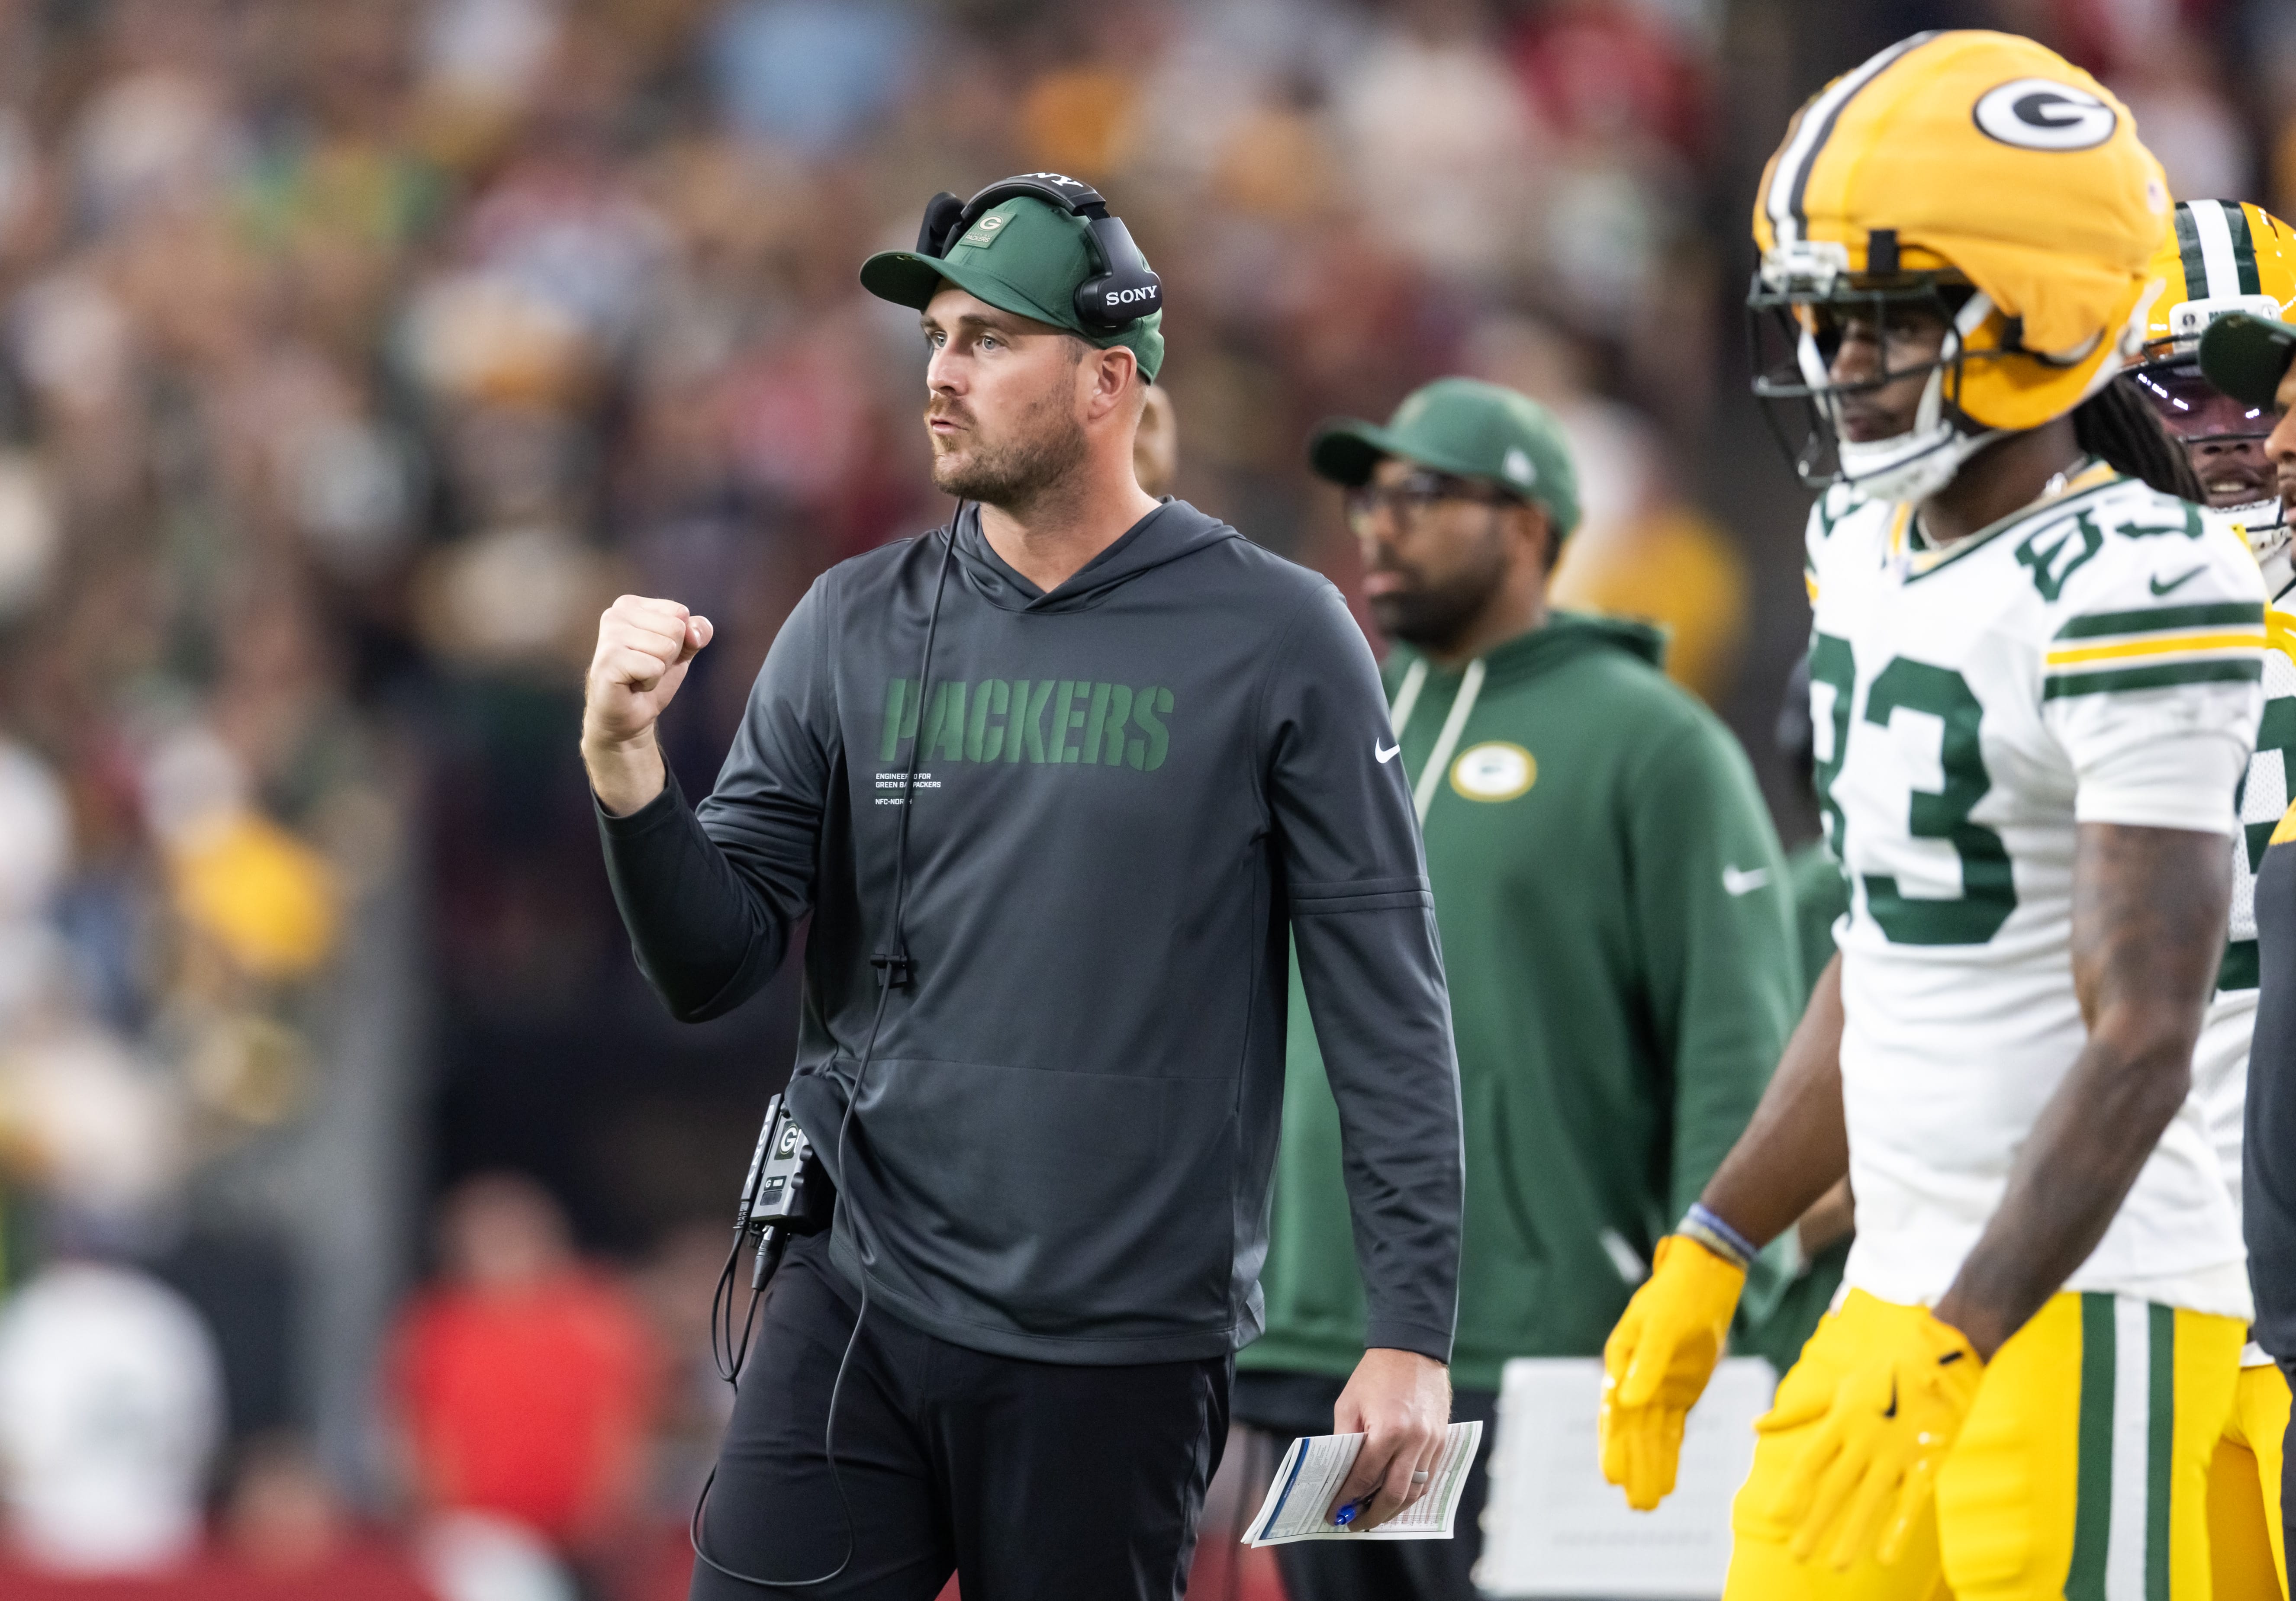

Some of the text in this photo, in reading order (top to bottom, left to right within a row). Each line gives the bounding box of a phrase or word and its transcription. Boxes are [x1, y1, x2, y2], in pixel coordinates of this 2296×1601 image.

[979, 217, 1002, 230] G
[1106, 285, 1157, 305] SONY
[879, 678, 1175, 772] PACKERS
[781, 1127, 797, 1152] G
[765, 1180, 772, 1188] G
